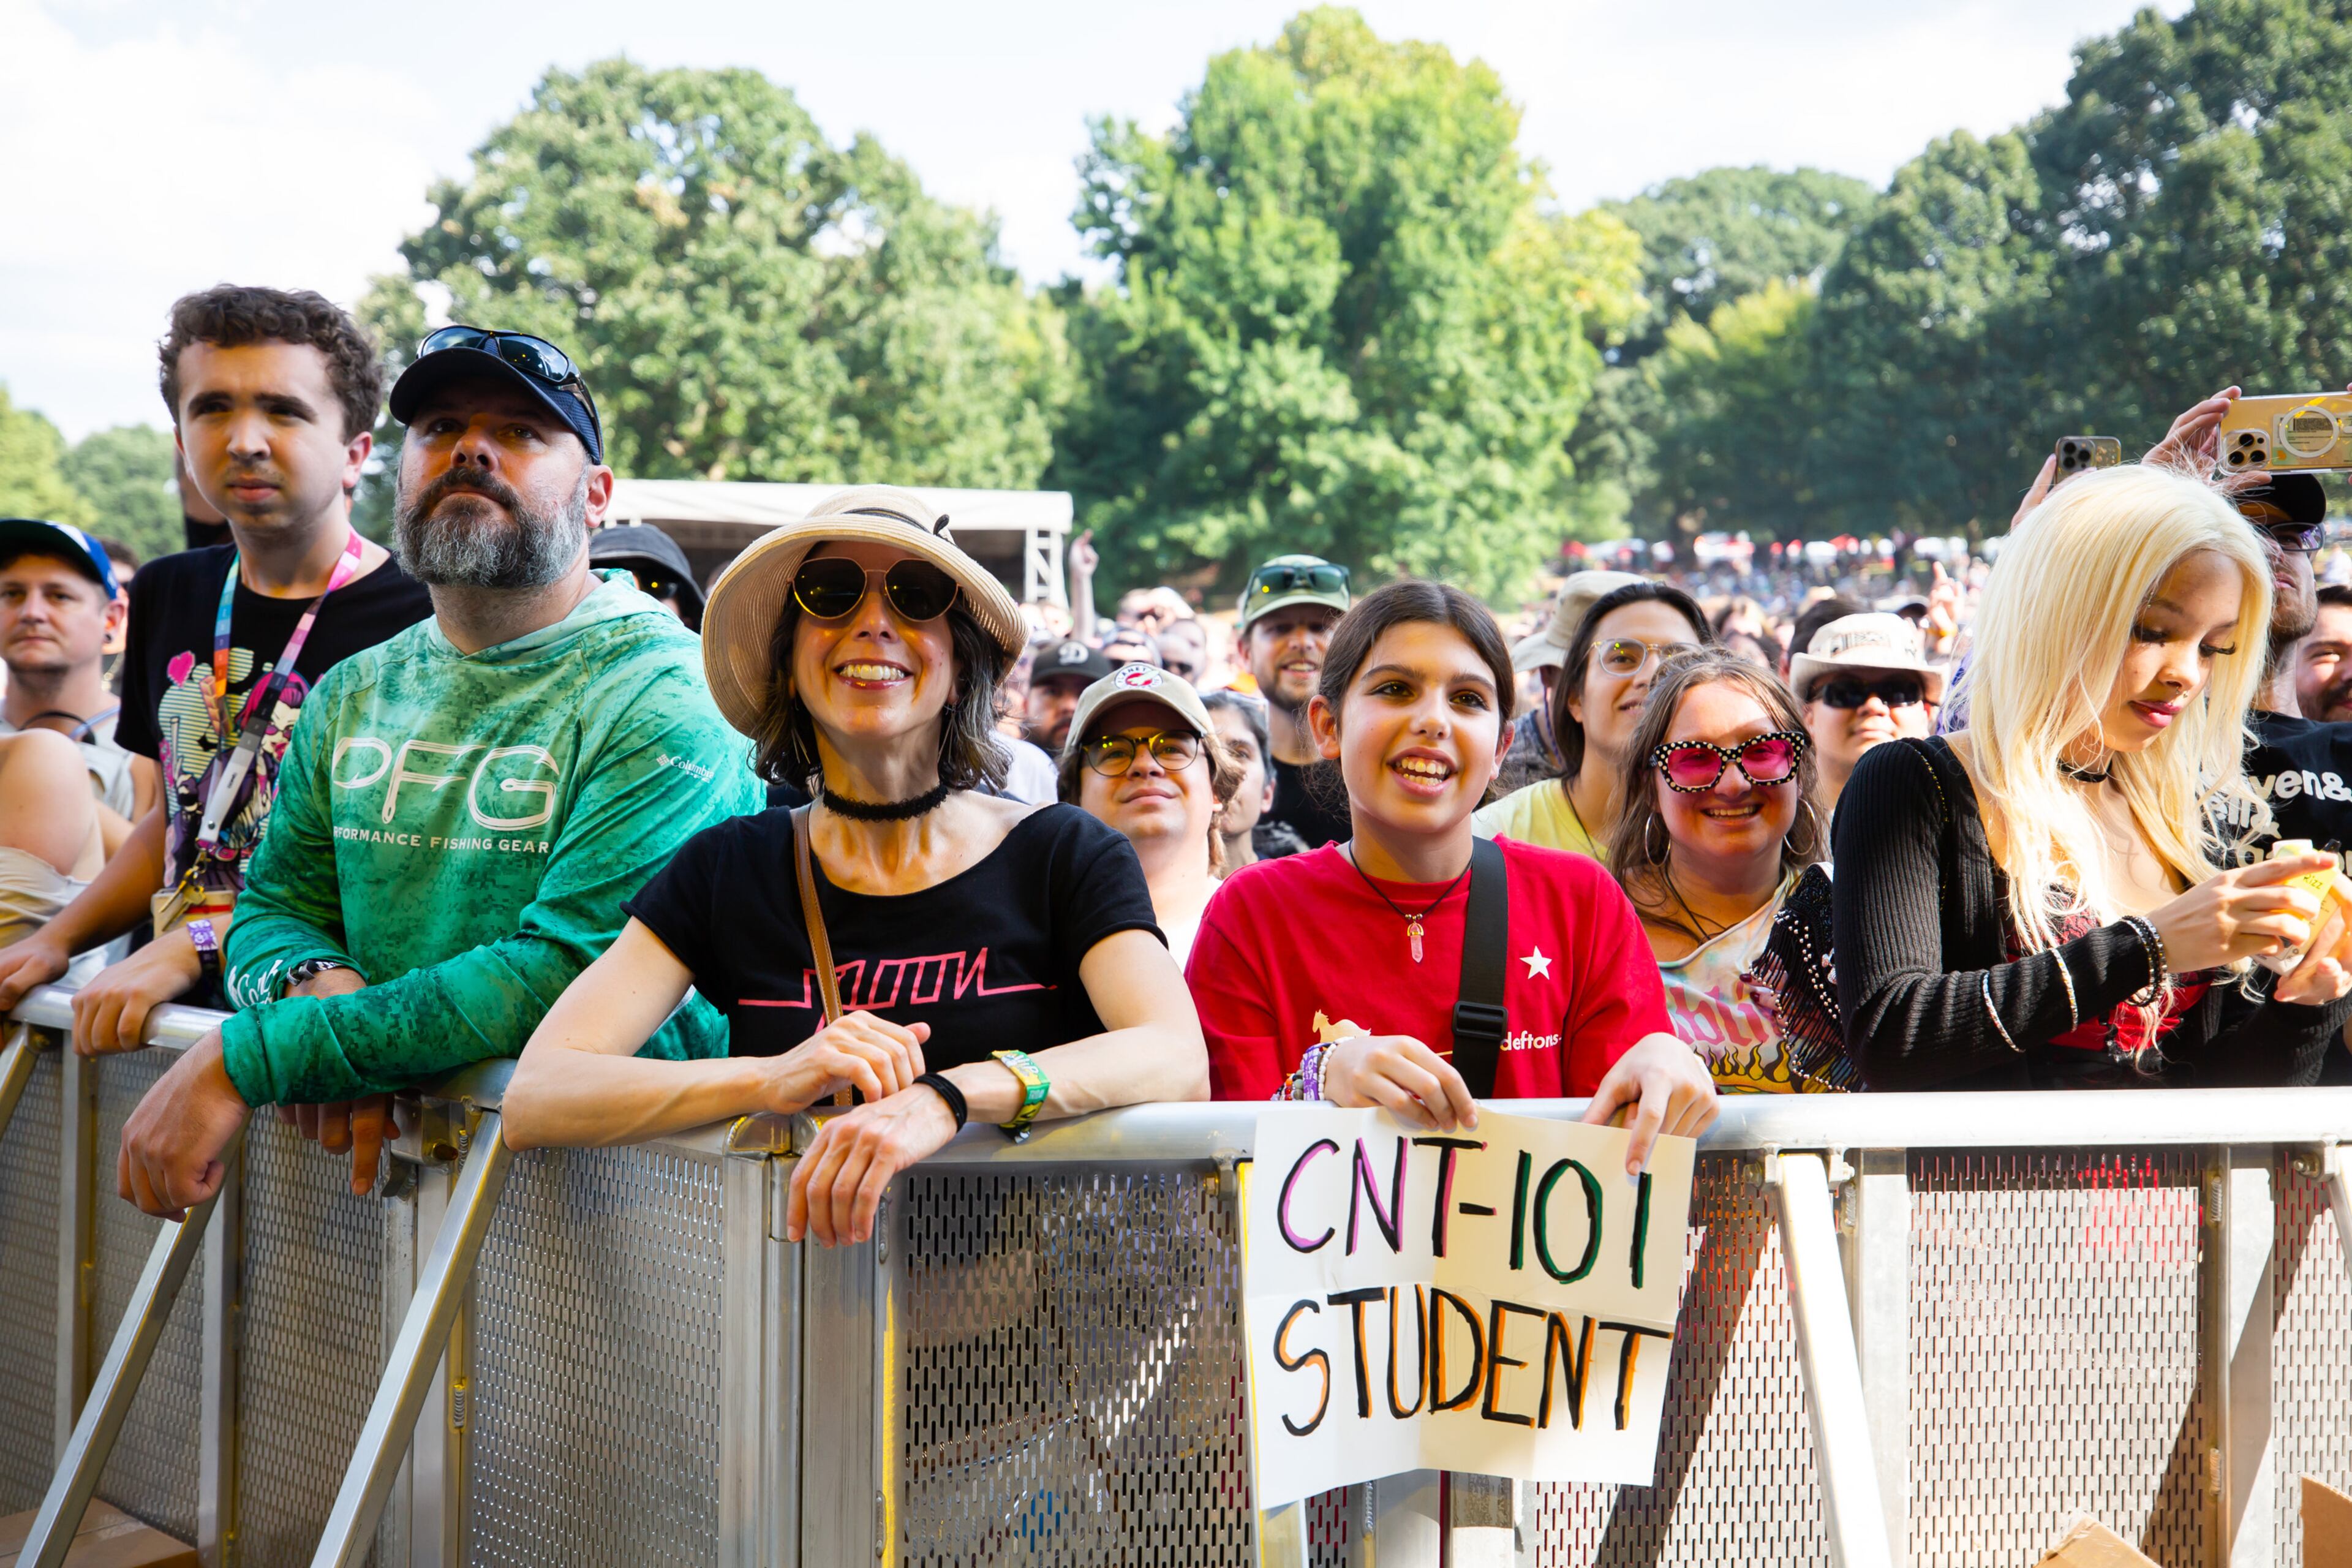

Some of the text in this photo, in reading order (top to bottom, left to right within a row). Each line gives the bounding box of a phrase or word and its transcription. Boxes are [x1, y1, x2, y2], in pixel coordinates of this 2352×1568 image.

[331, 737, 559, 831] PFG
[670, 755, 715, 780] Columbia
[333, 826, 549, 853] RFORMANCE FISHING GEAR
[1277, 1136, 1652, 1289] CNT-101
[1273, 1284, 1674, 1437] STUDENT
